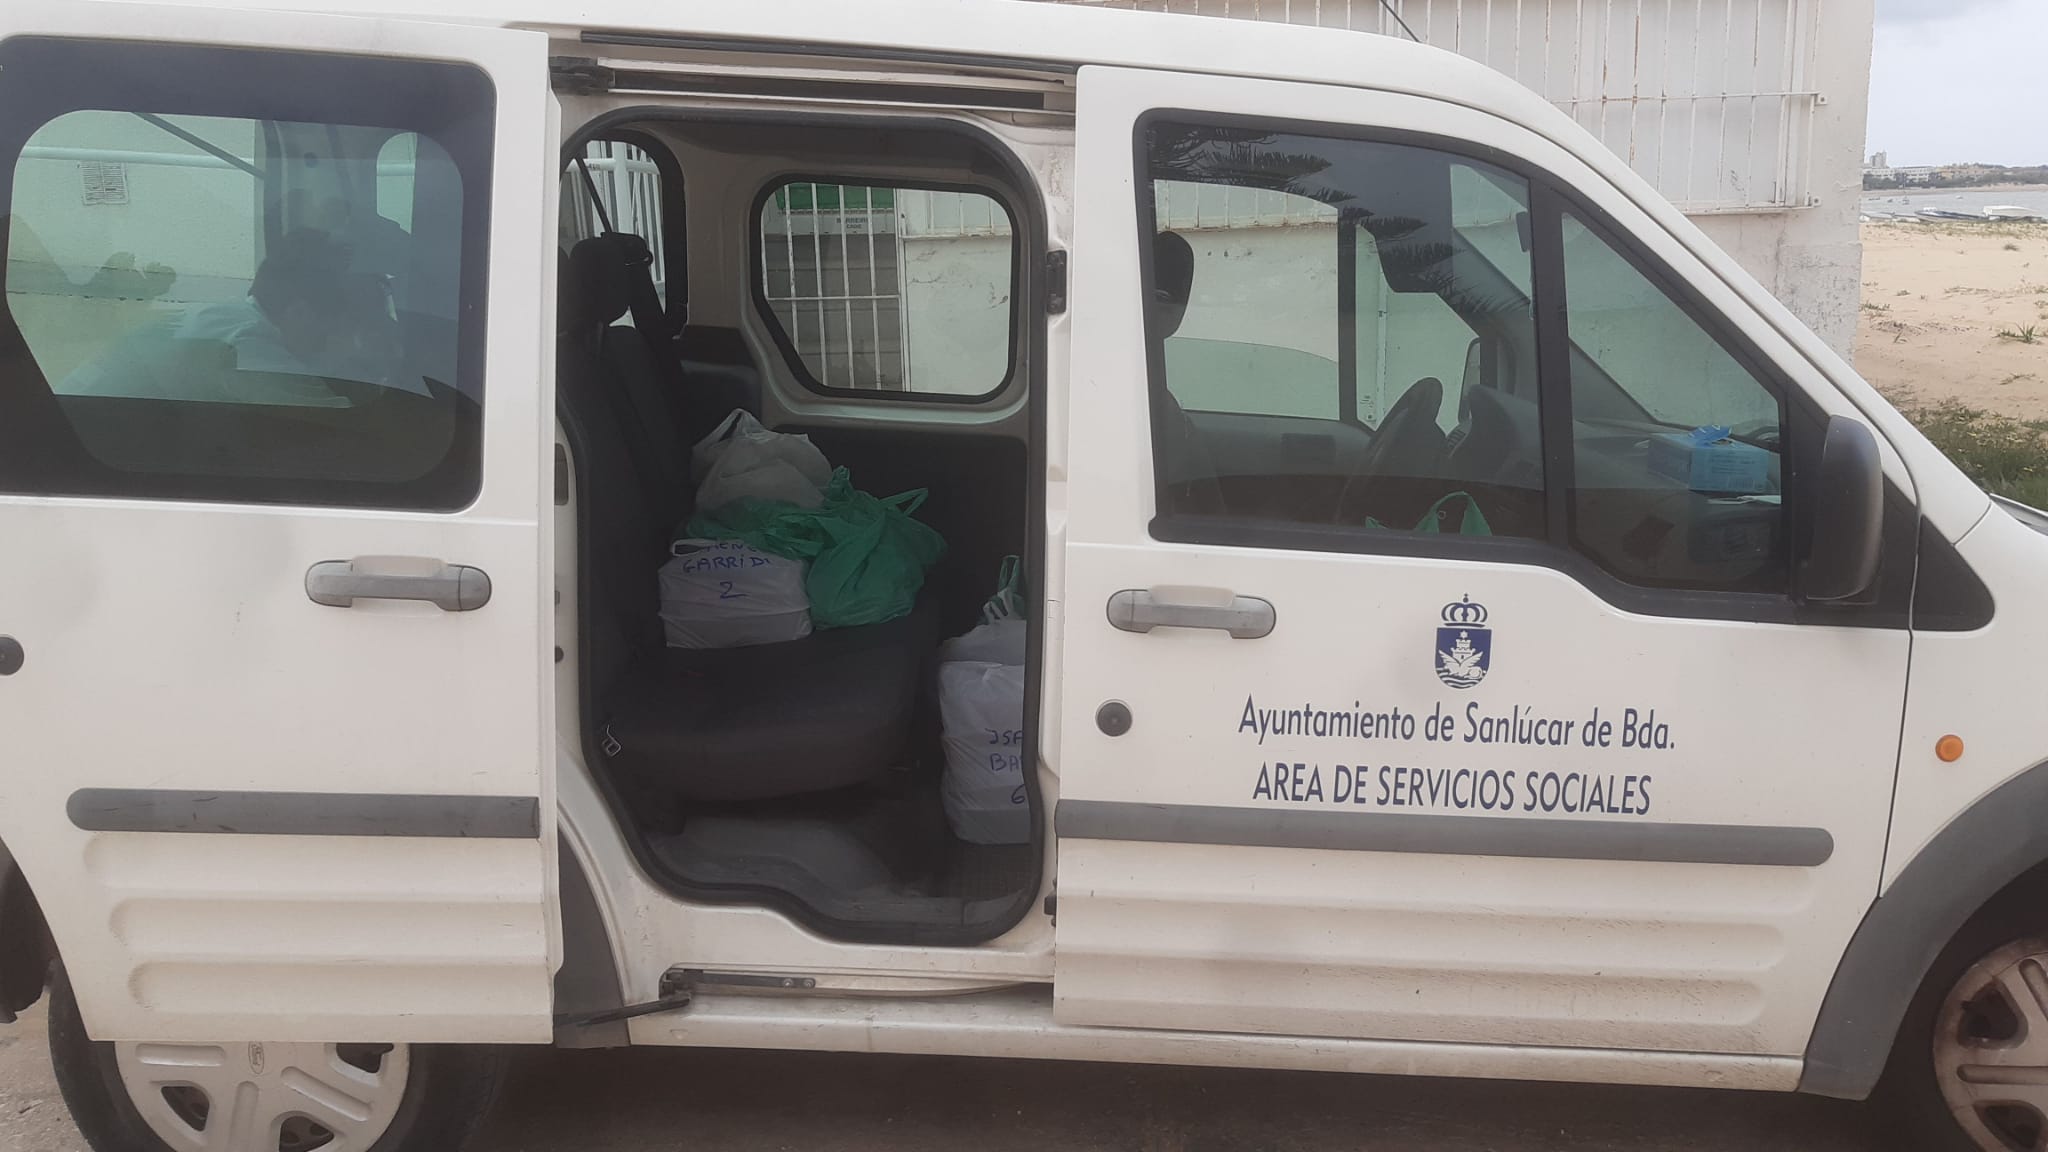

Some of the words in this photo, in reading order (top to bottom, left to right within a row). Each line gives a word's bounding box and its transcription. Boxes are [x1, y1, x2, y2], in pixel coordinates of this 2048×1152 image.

[720, 581, 752, 599] 2
[1238, 692, 1415, 746] Ayuntamiento
[1424, 701, 1454, 742] de
[1463, 701, 1575, 746] Sanlúcar
[1582, 706, 1612, 748] de
[1622, 708, 1675, 750] Bda.
[990, 753, 1023, 773] BA
[1011, 783, 1026, 805] 6
[1252, 761, 1324, 802] AREA
[1333, 764, 1368, 805] DE
[1376, 765, 1516, 811] SERVICIOS
[1523, 771, 1652, 816] SOCIALES
